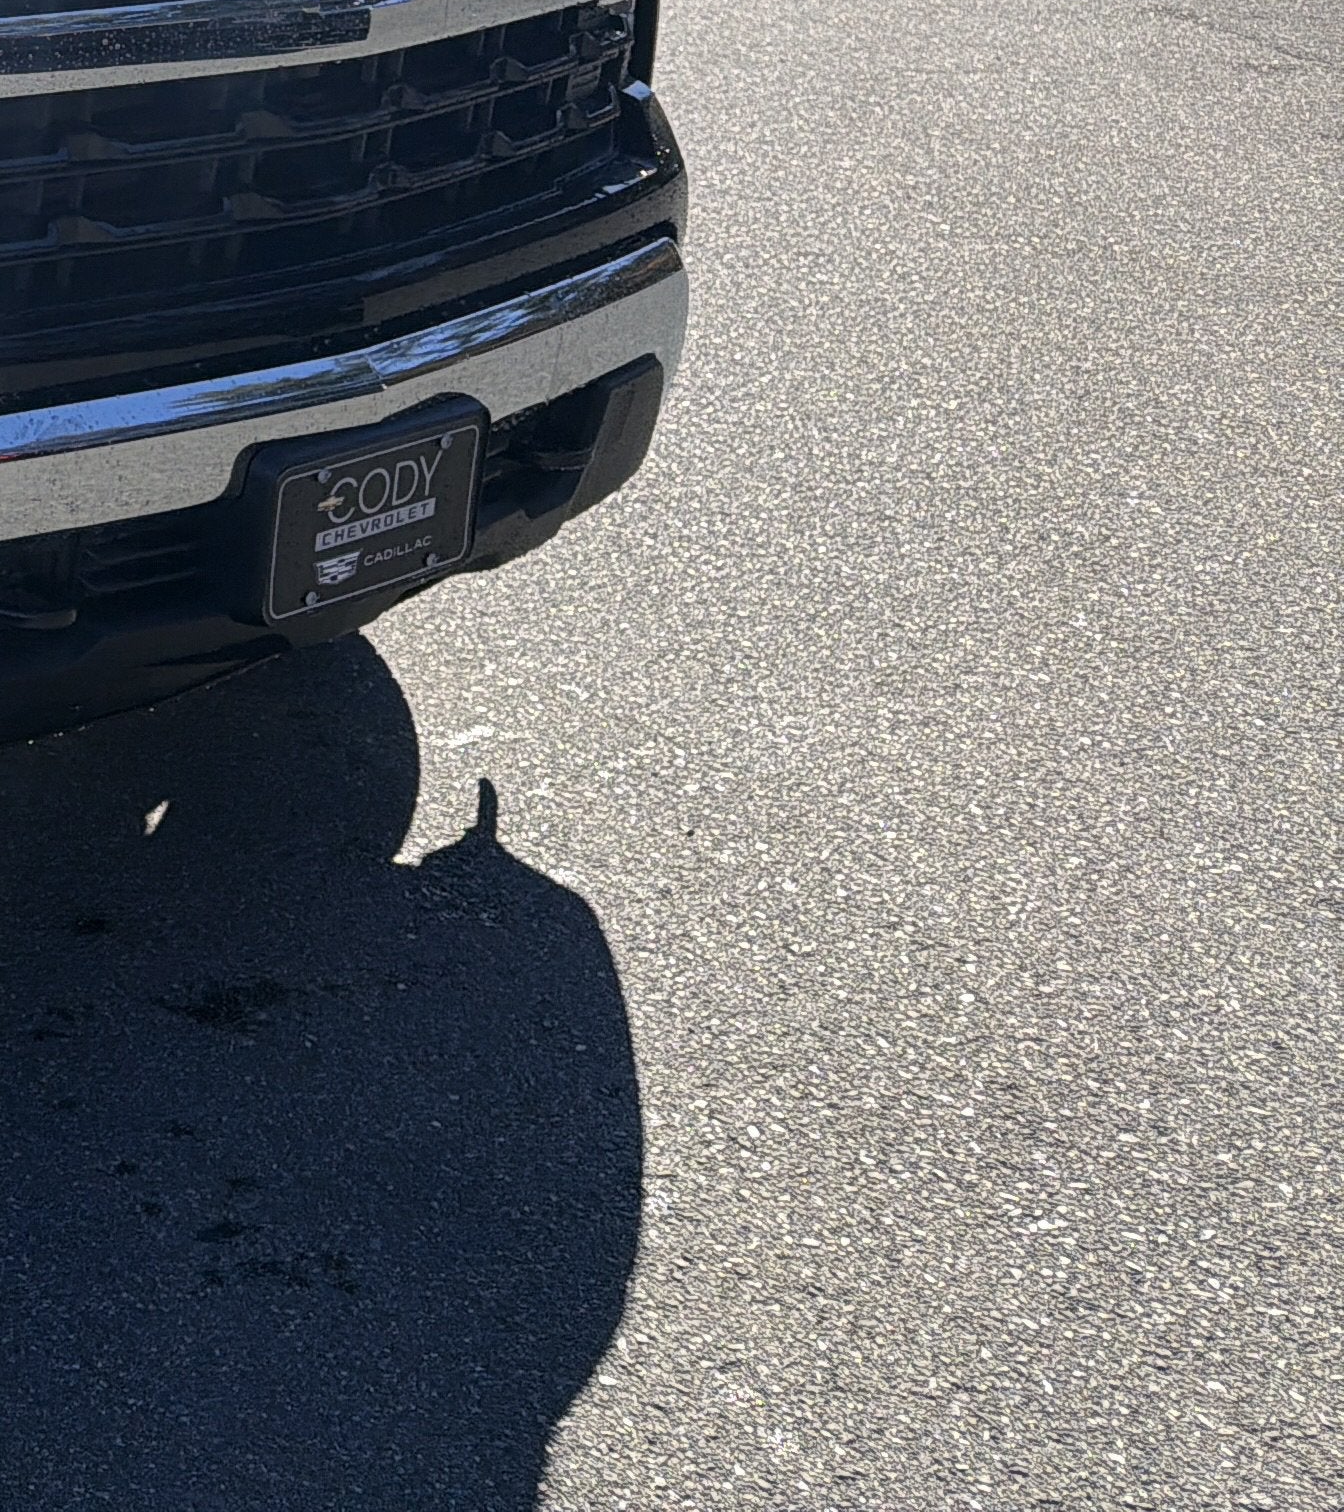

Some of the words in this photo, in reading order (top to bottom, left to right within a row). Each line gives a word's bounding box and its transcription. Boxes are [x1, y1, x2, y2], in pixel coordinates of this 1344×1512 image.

[327, 449, 443, 524] CODY
[320, 502, 431, 548] CHEVROLET
[363, 535, 433, 568] CADILLAC
